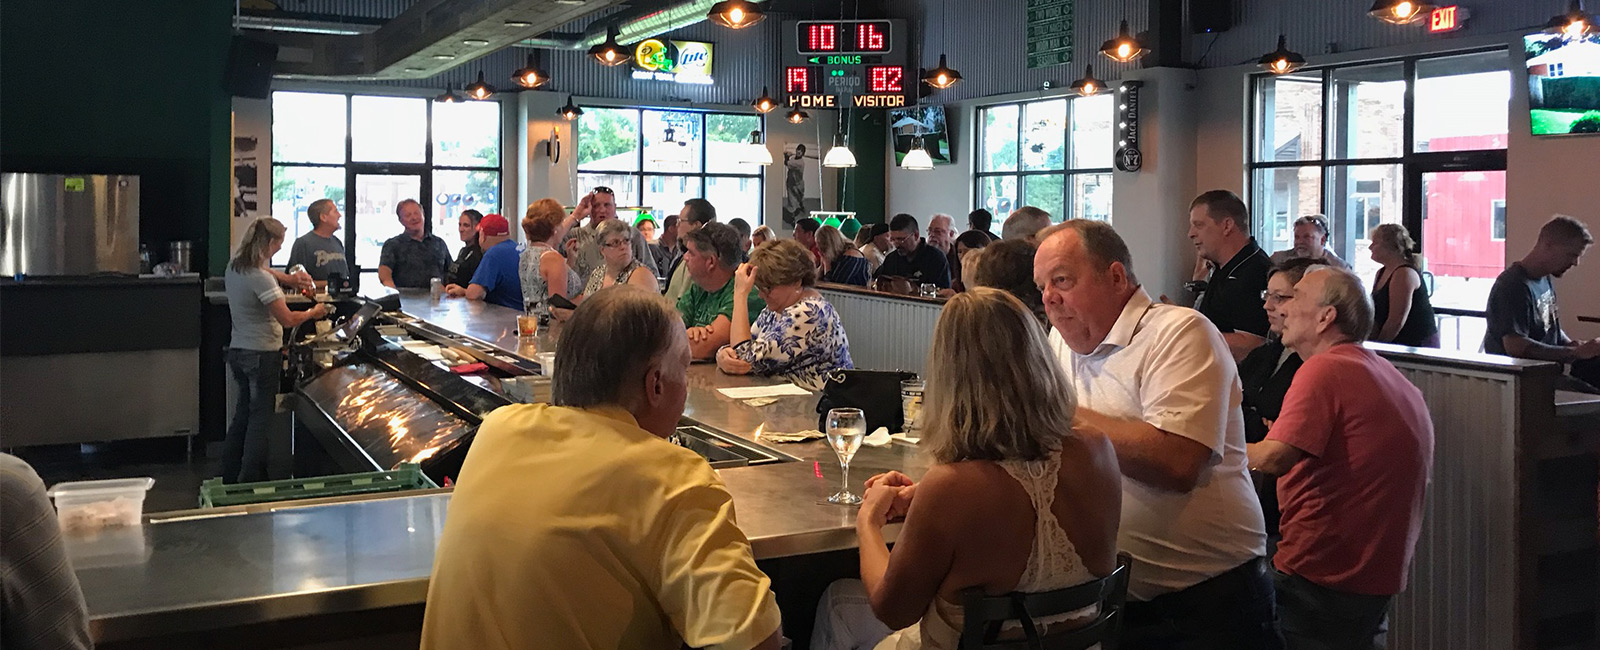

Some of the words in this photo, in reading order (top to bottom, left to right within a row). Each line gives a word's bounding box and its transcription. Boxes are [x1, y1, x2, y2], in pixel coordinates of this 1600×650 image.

[1431, 6, 1456, 31] EXIT
[827, 55, 862, 65] BONUS
[828, 76, 860, 87] PERIOD
[789, 95, 835, 107] HOME
[854, 95, 905, 107] VISITOR
